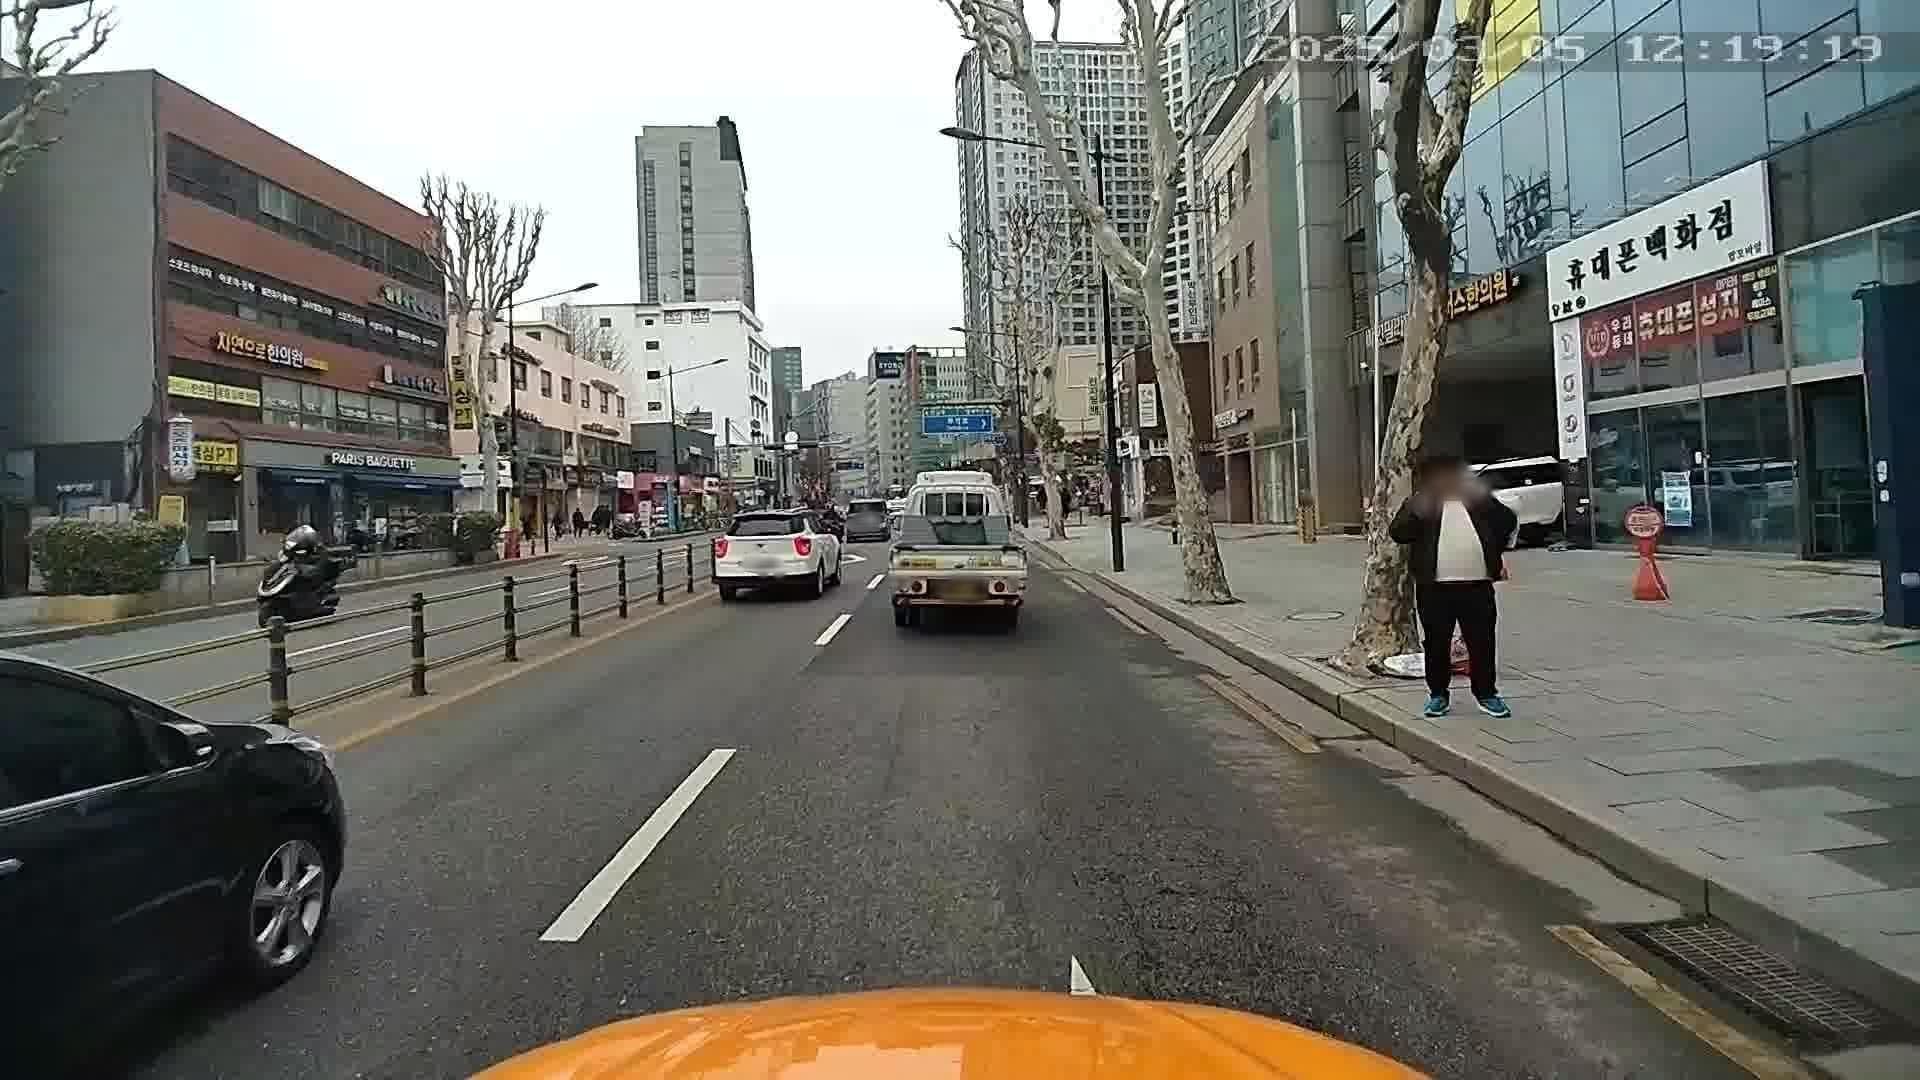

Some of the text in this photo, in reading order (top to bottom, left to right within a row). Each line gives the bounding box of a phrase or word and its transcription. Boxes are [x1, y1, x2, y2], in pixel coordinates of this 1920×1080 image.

[1565, 199, 1734, 291] 휴대폰백화점
[1639, 300, 1694, 341] 휴대폰
[1699, 287, 1740, 326] 성지
[1611, 315, 1632, 333] 우리
[1612, 331, 1633, 349] 동네
[331, 452, 417, 470] PARIS BAGUETTE
